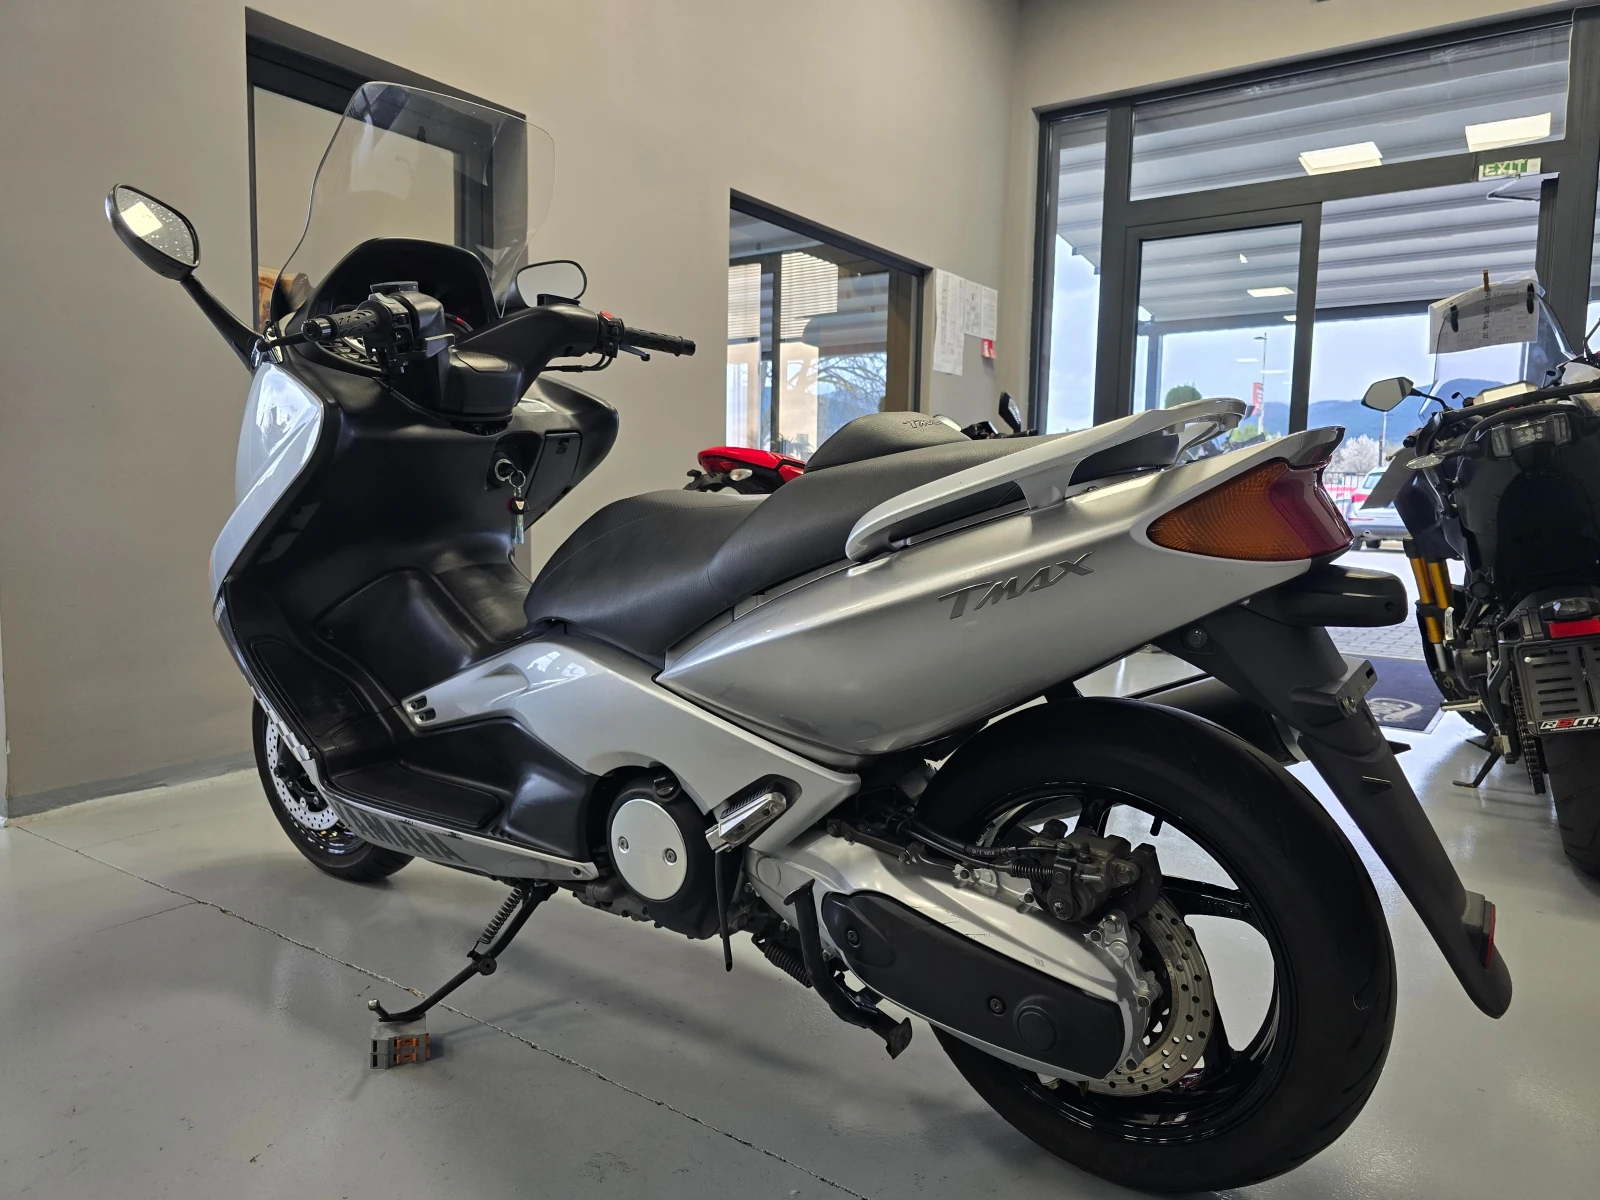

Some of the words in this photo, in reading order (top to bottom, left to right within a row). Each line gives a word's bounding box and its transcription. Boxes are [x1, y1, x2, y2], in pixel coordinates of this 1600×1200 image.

[1484, 158, 1528, 176] EXIT
[937, 551, 1095, 620] TMAX
[1540, 716, 1600, 730] RSM
[332, 799, 468, 863] YAMAHA
